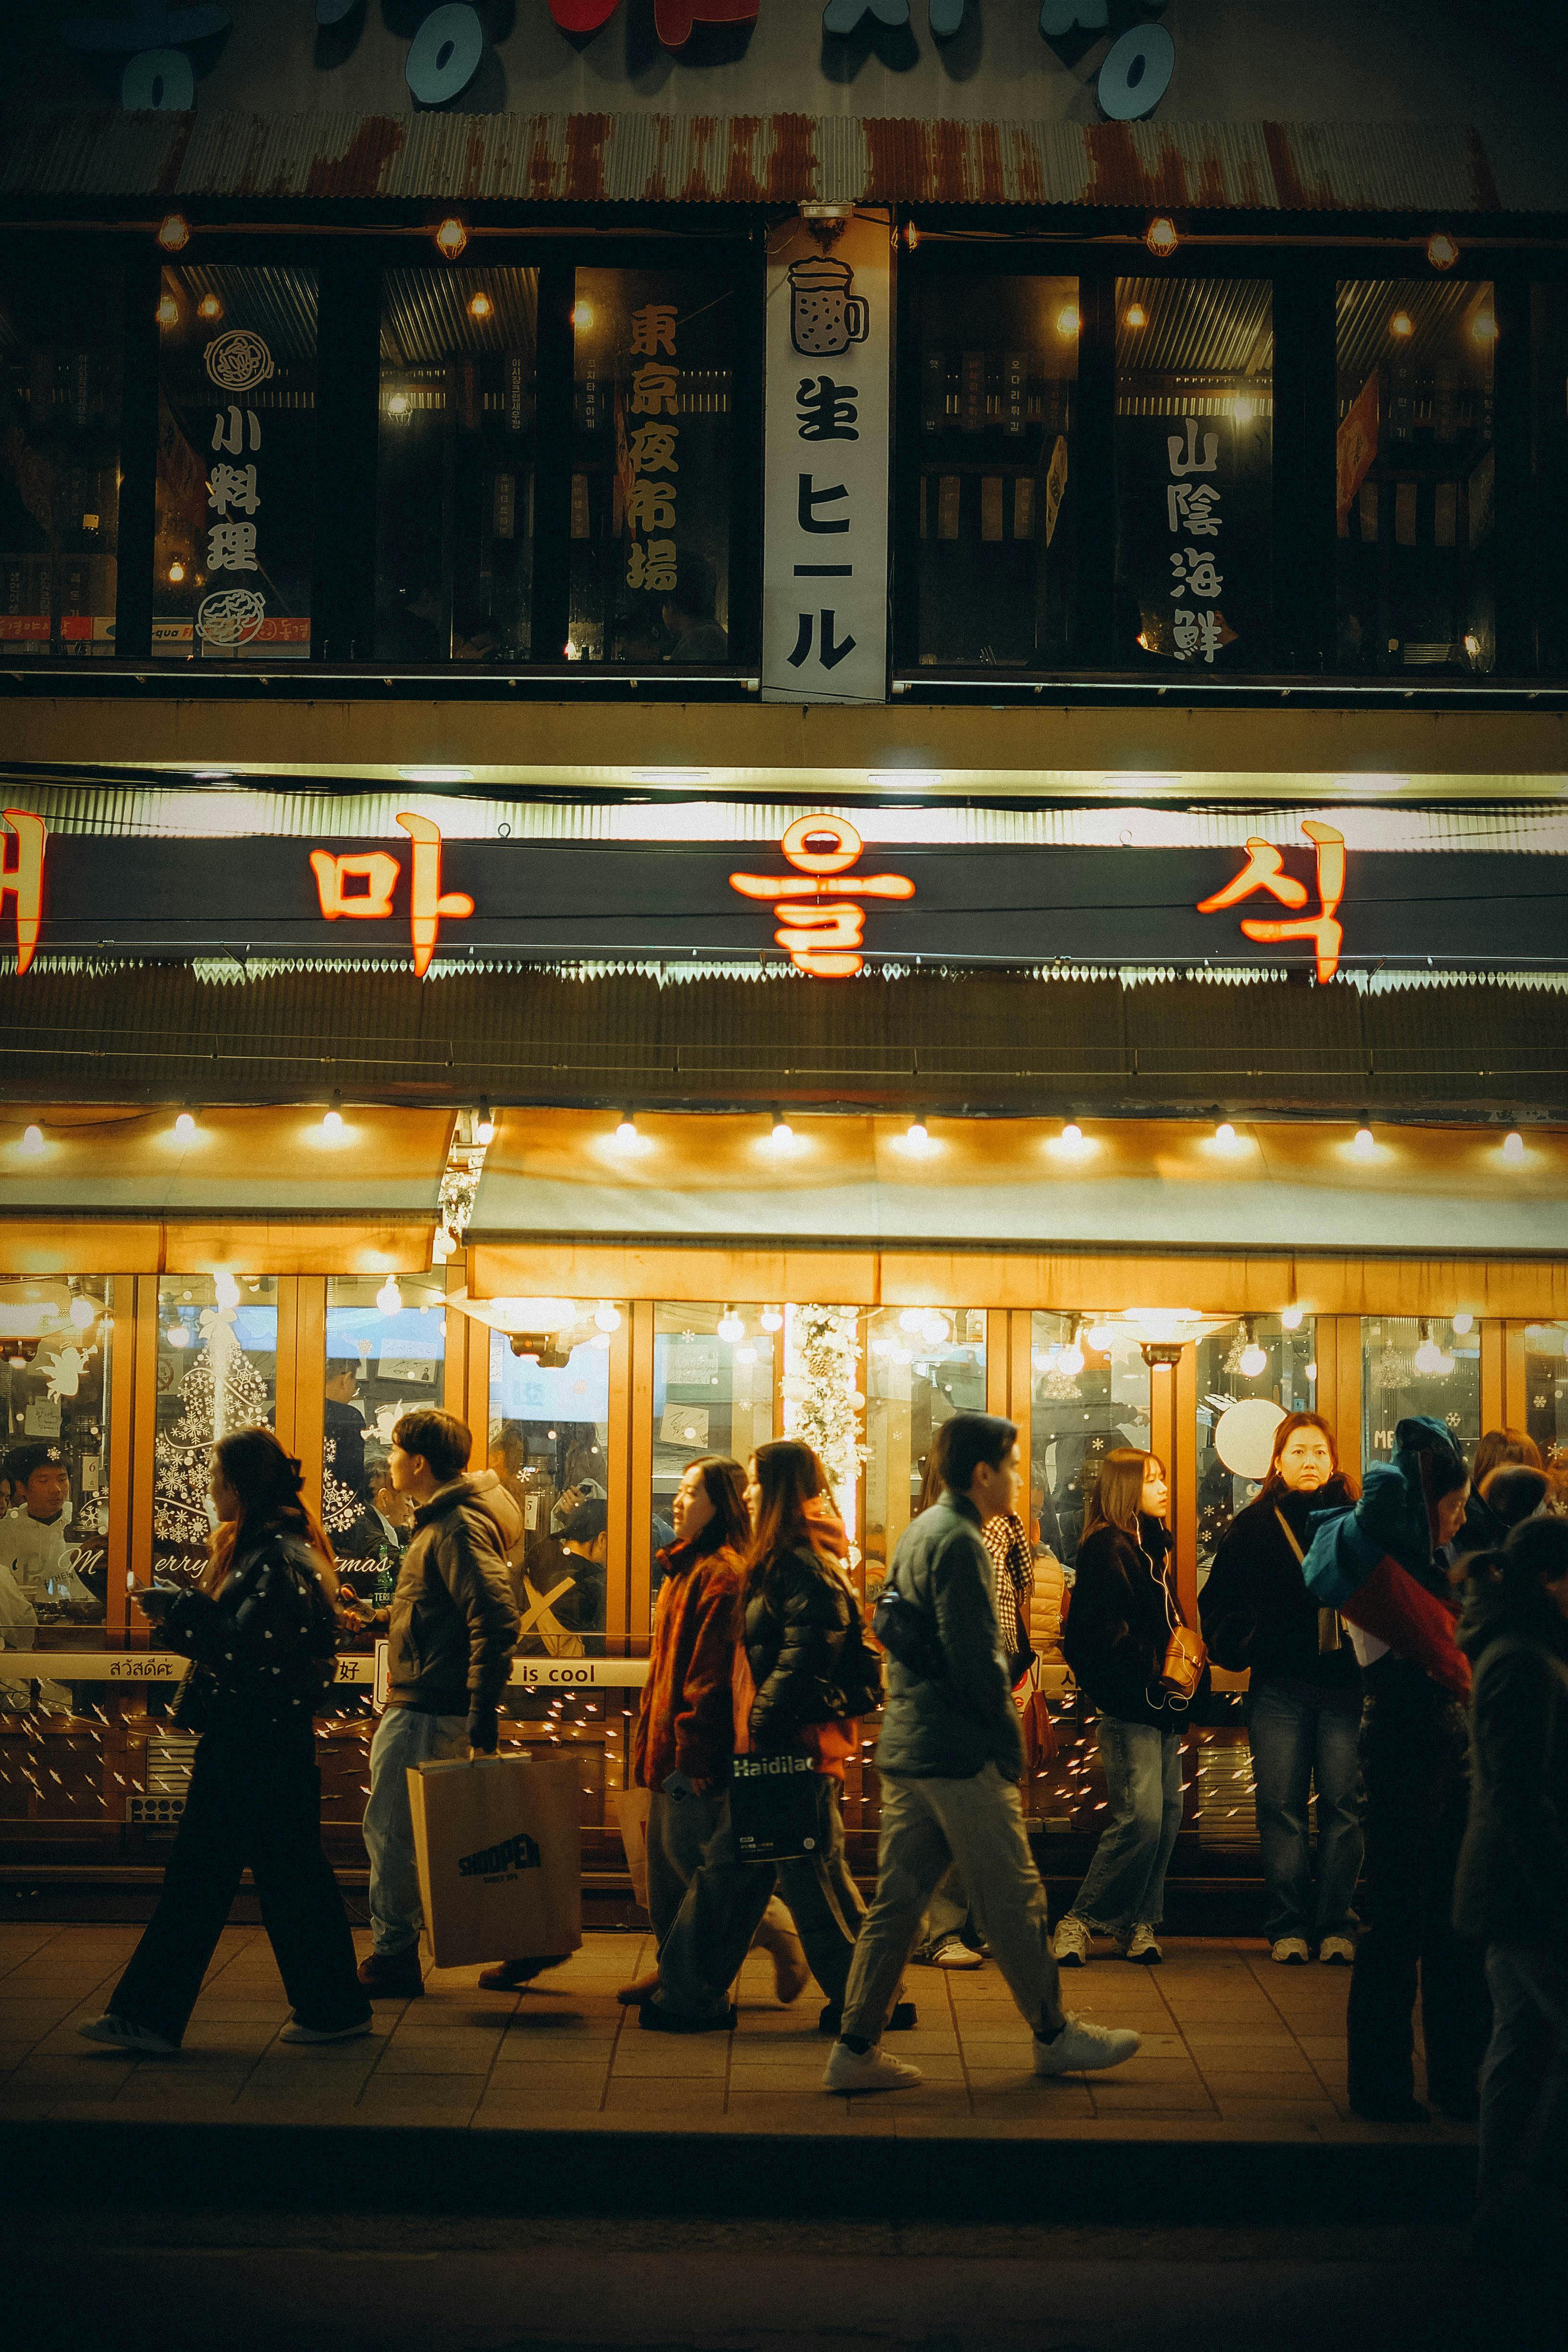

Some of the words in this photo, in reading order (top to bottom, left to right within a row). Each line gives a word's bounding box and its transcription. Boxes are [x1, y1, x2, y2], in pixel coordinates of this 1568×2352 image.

[207, 405, 261, 571] 小料理
[110, 1657, 173, 1677] สวัสดีค่ะ
[523, 1666, 539, 1682] is
[549, 1665, 595, 1682] cool
